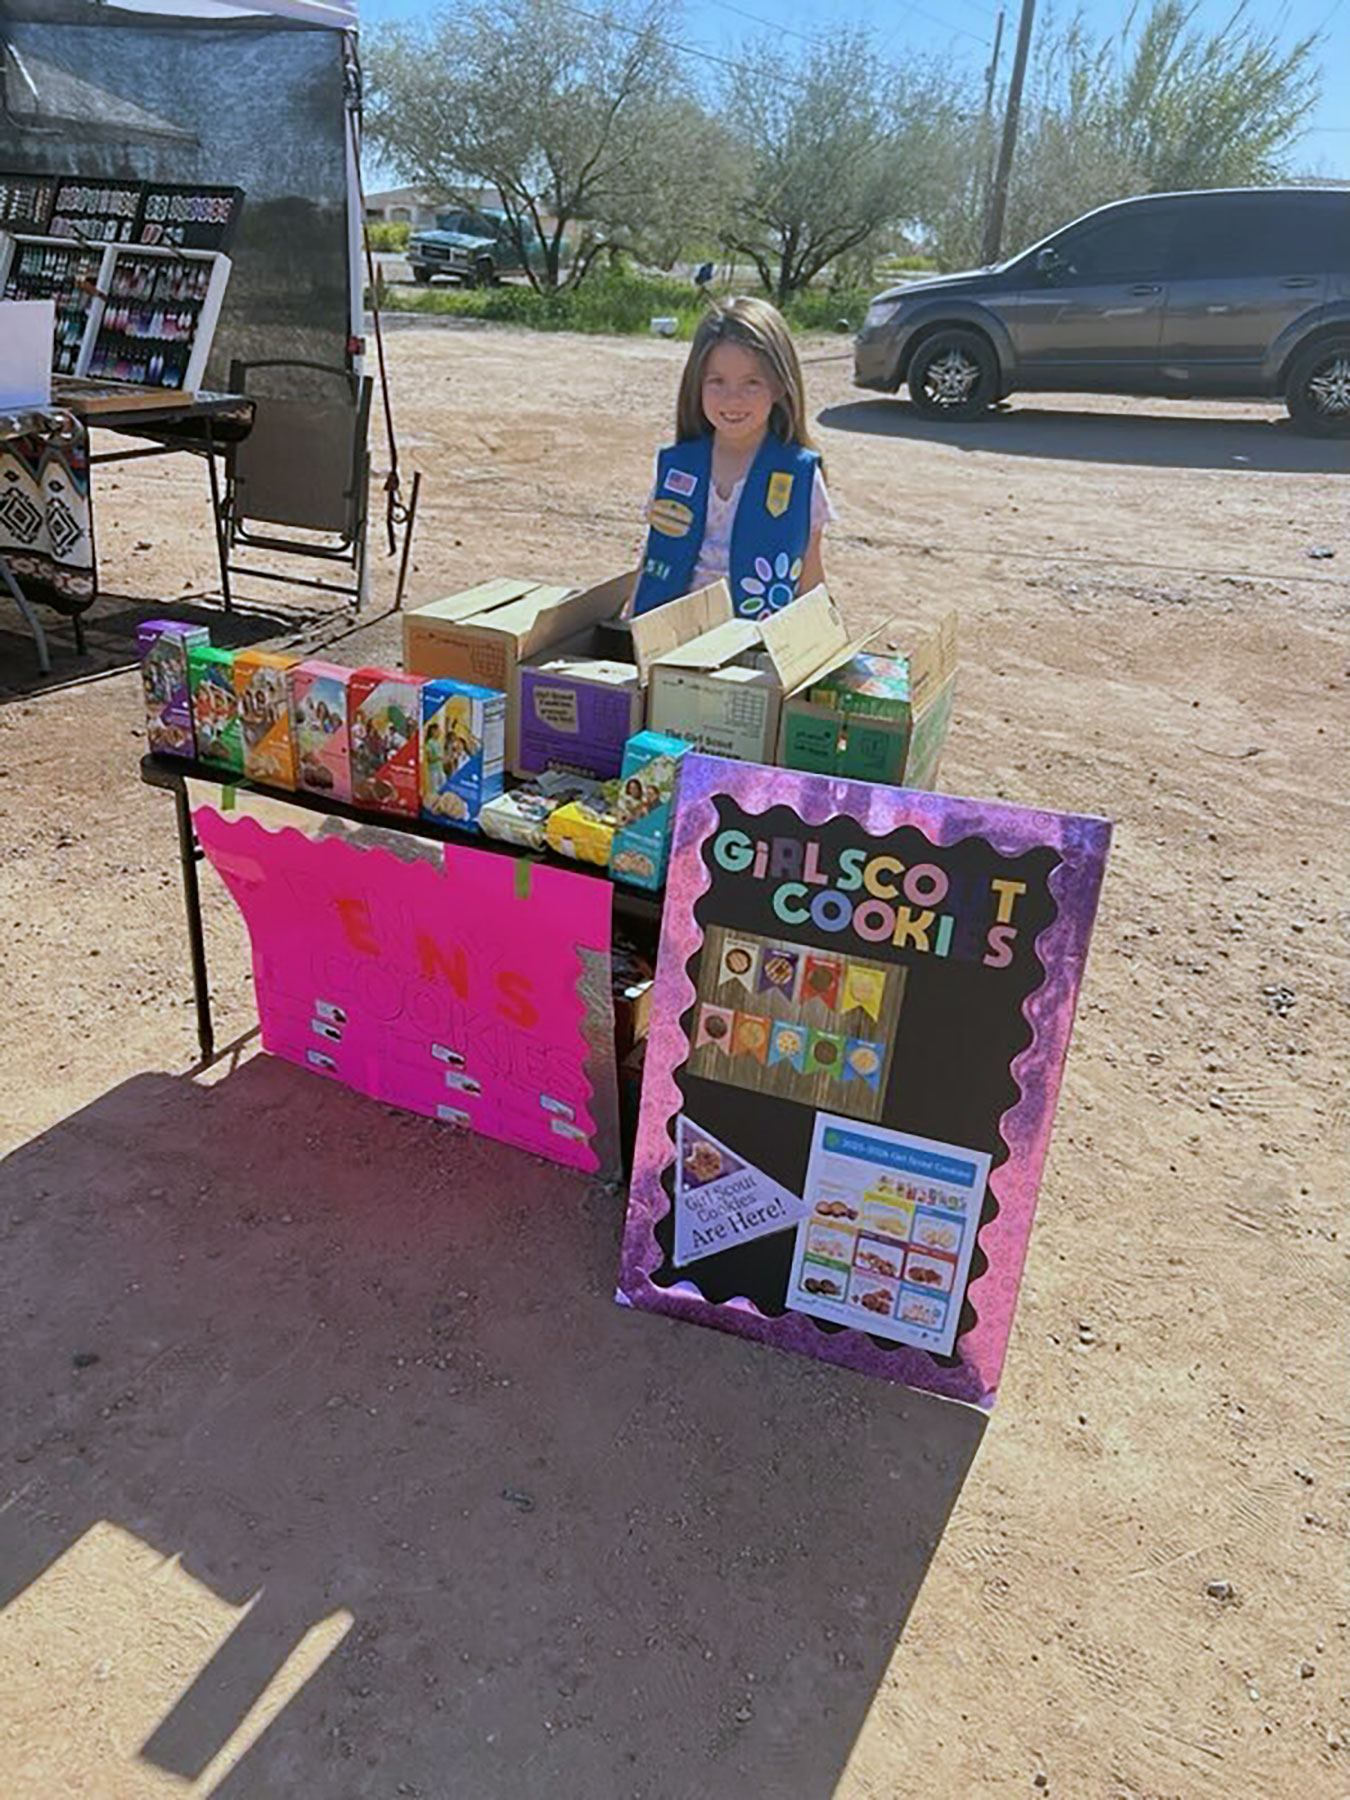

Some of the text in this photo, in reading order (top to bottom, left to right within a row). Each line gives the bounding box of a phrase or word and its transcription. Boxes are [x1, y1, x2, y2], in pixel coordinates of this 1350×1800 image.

[836, 848, 1027, 924] SCOT
[773, 882, 1018, 968] COOKIS
[685, 1174, 757, 1211] Girl Scout
[697, 1193, 757, 1223] Cookies
[692, 1197, 787, 1248] Are Here!
